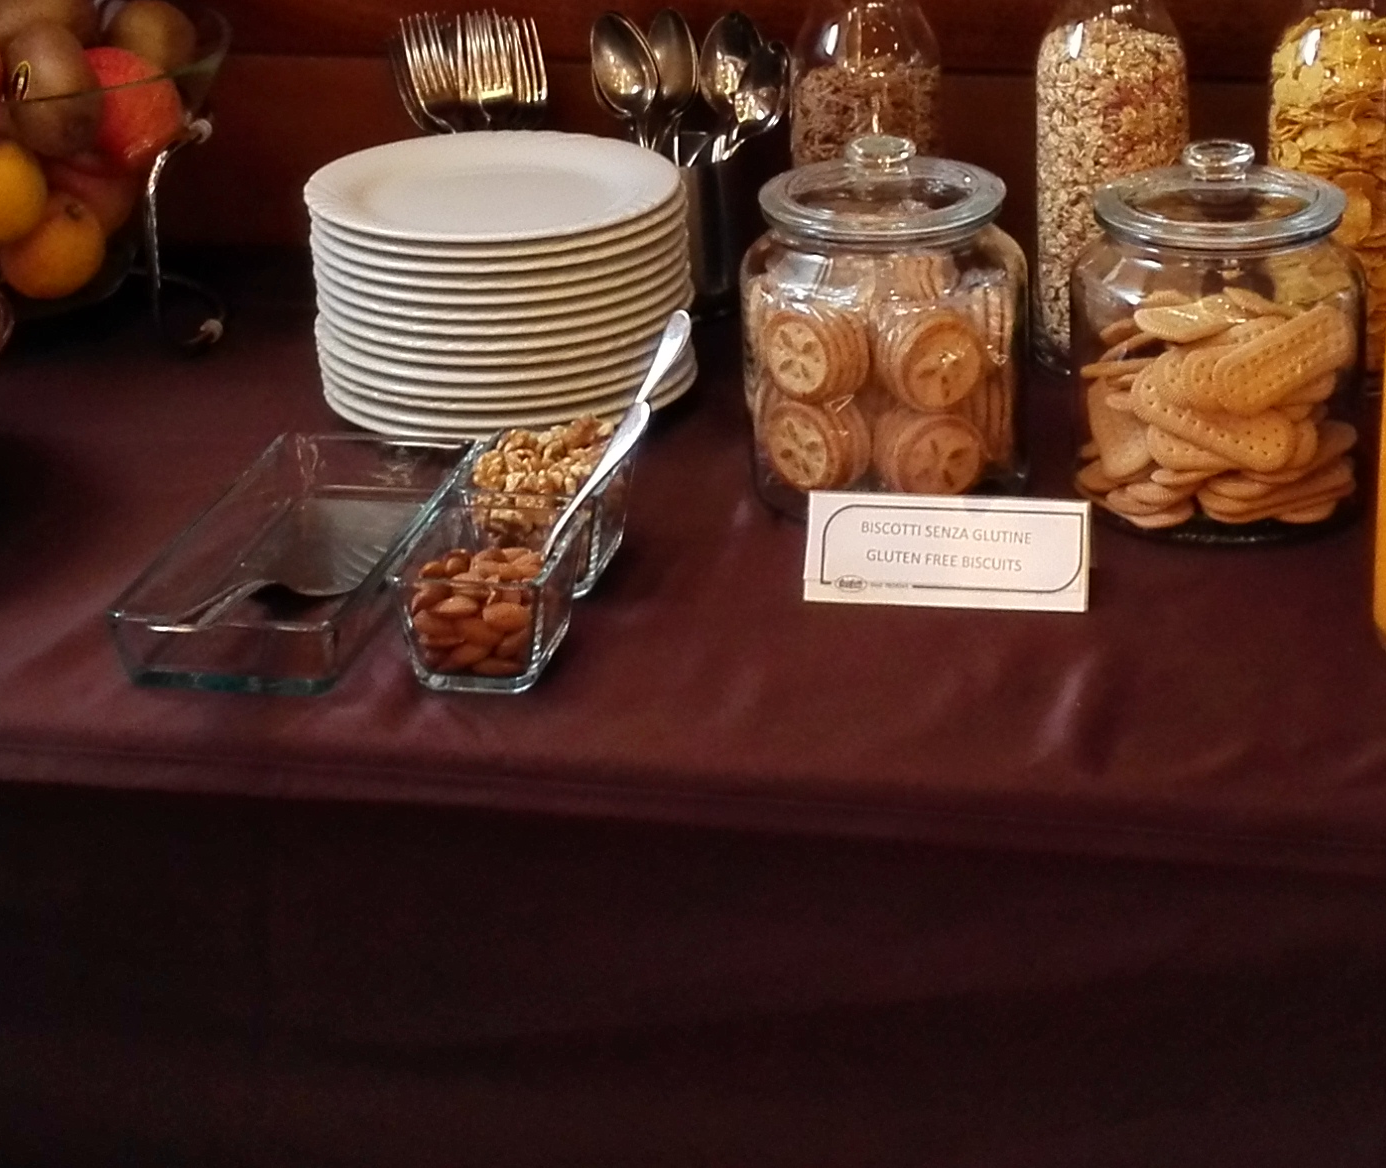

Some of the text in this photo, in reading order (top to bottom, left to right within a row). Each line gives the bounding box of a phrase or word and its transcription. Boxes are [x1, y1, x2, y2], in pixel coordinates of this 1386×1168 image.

[861, 521, 1033, 545] BISCOTTI SENZA GLUTINE
[866, 548, 1023, 572] GLUTEN FREE BISCUITS
